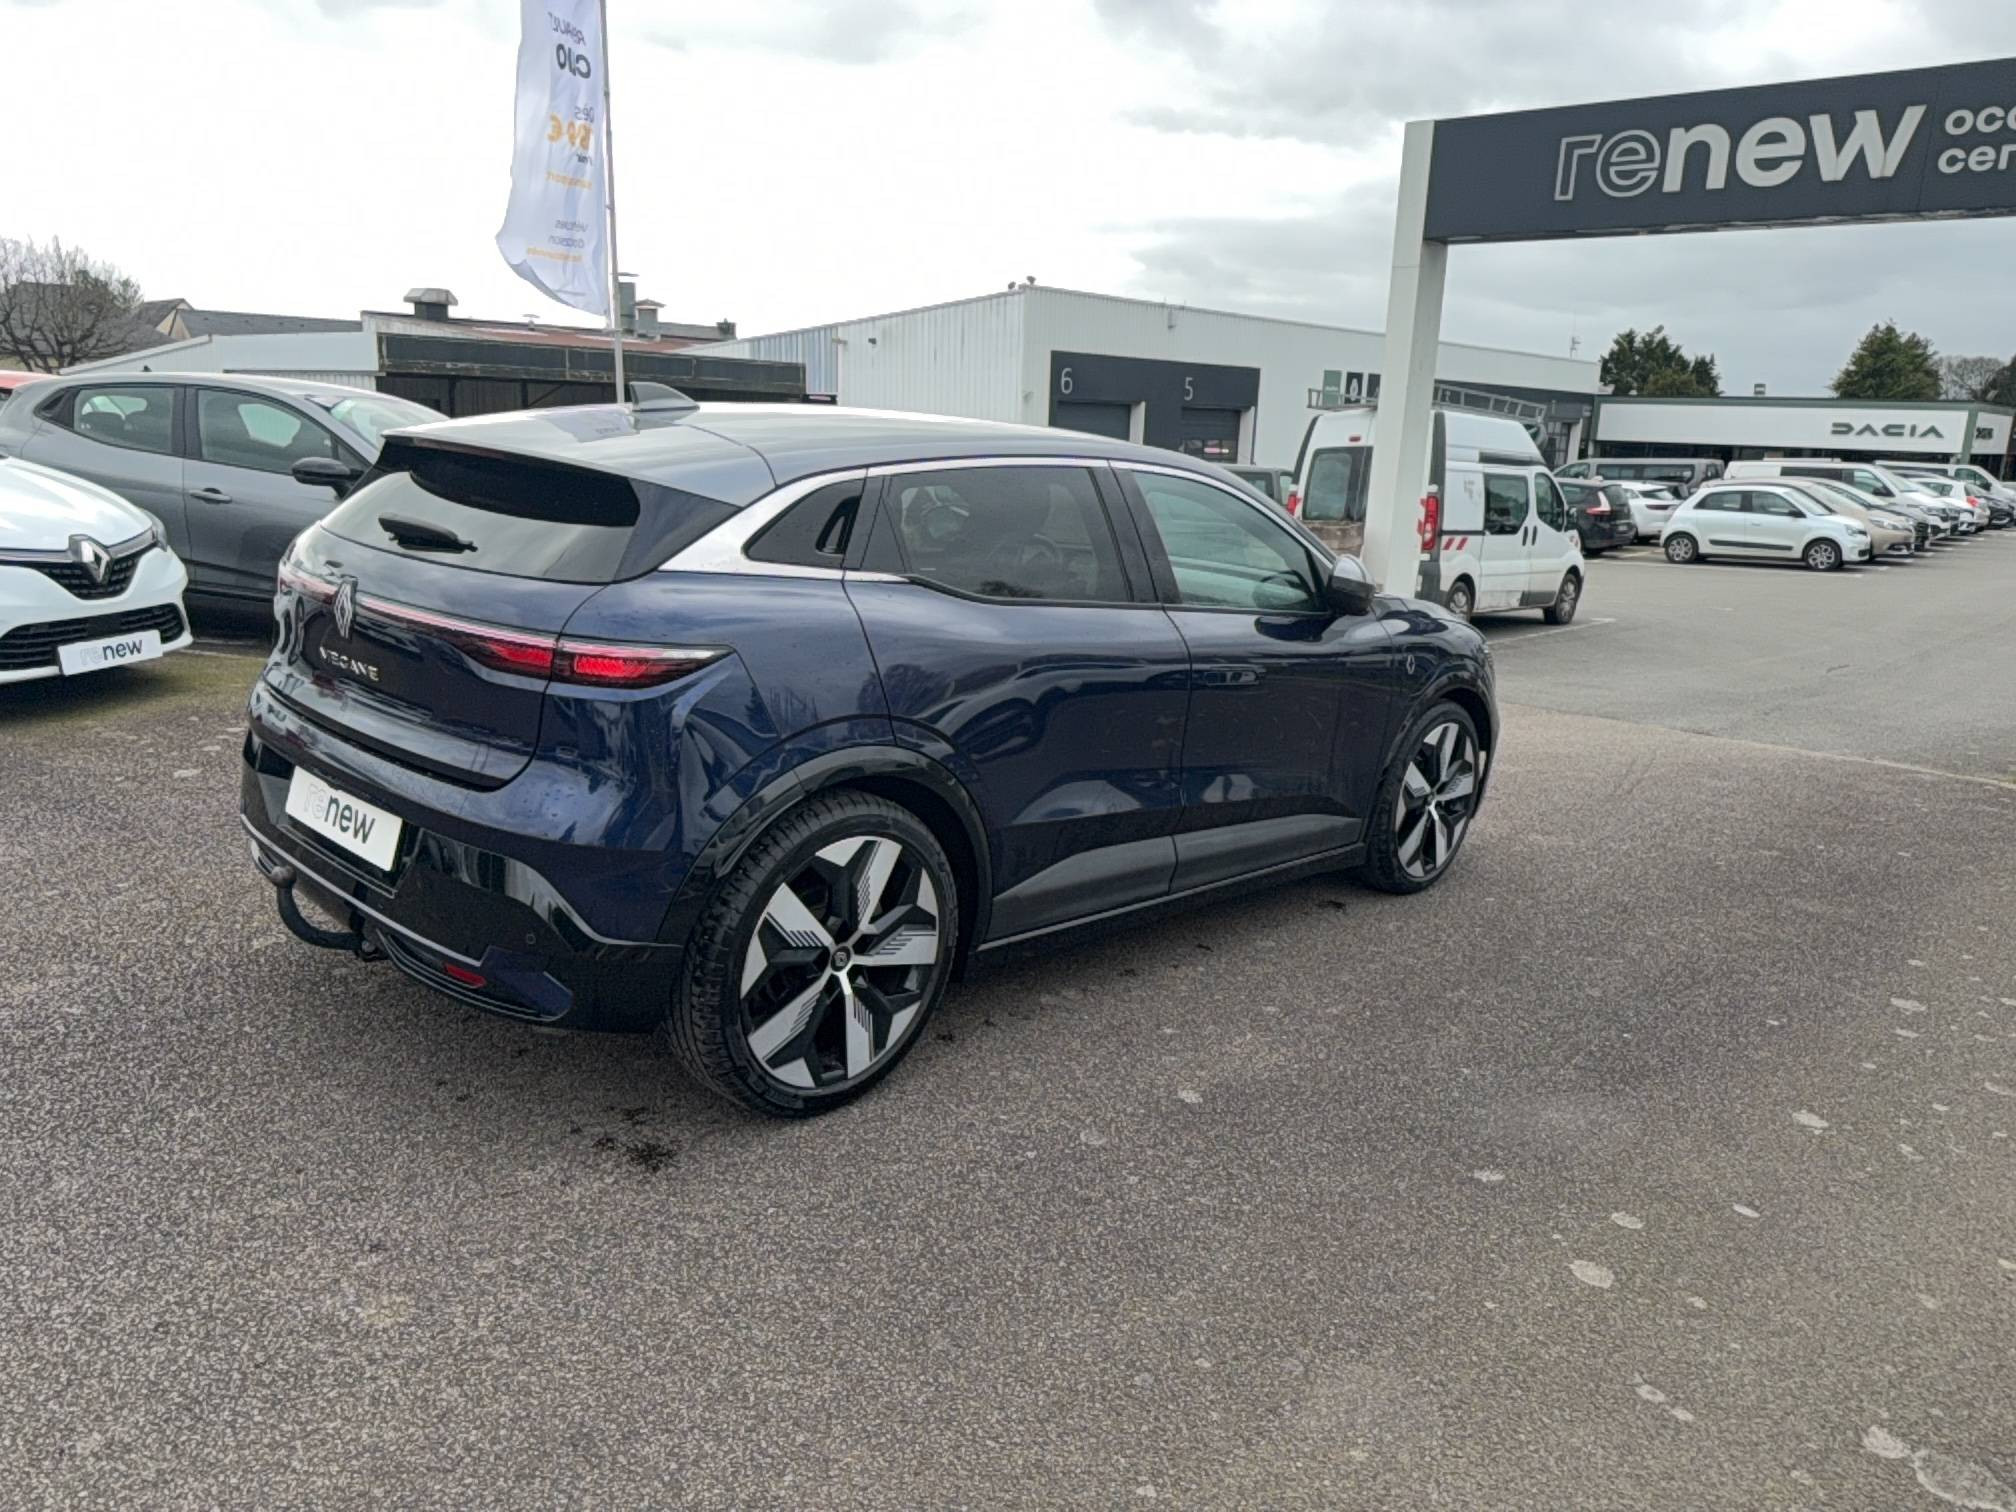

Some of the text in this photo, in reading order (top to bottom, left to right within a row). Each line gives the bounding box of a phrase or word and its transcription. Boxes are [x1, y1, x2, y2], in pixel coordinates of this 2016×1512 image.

[1554, 105, 1927, 200] renew
[1060, 367, 1072, 394] 6
[1184, 377, 1193, 400] 5
[1831, 421, 1944, 439] DACIA
[80, 638, 142, 666] renew
[305, 783, 376, 845] renew
